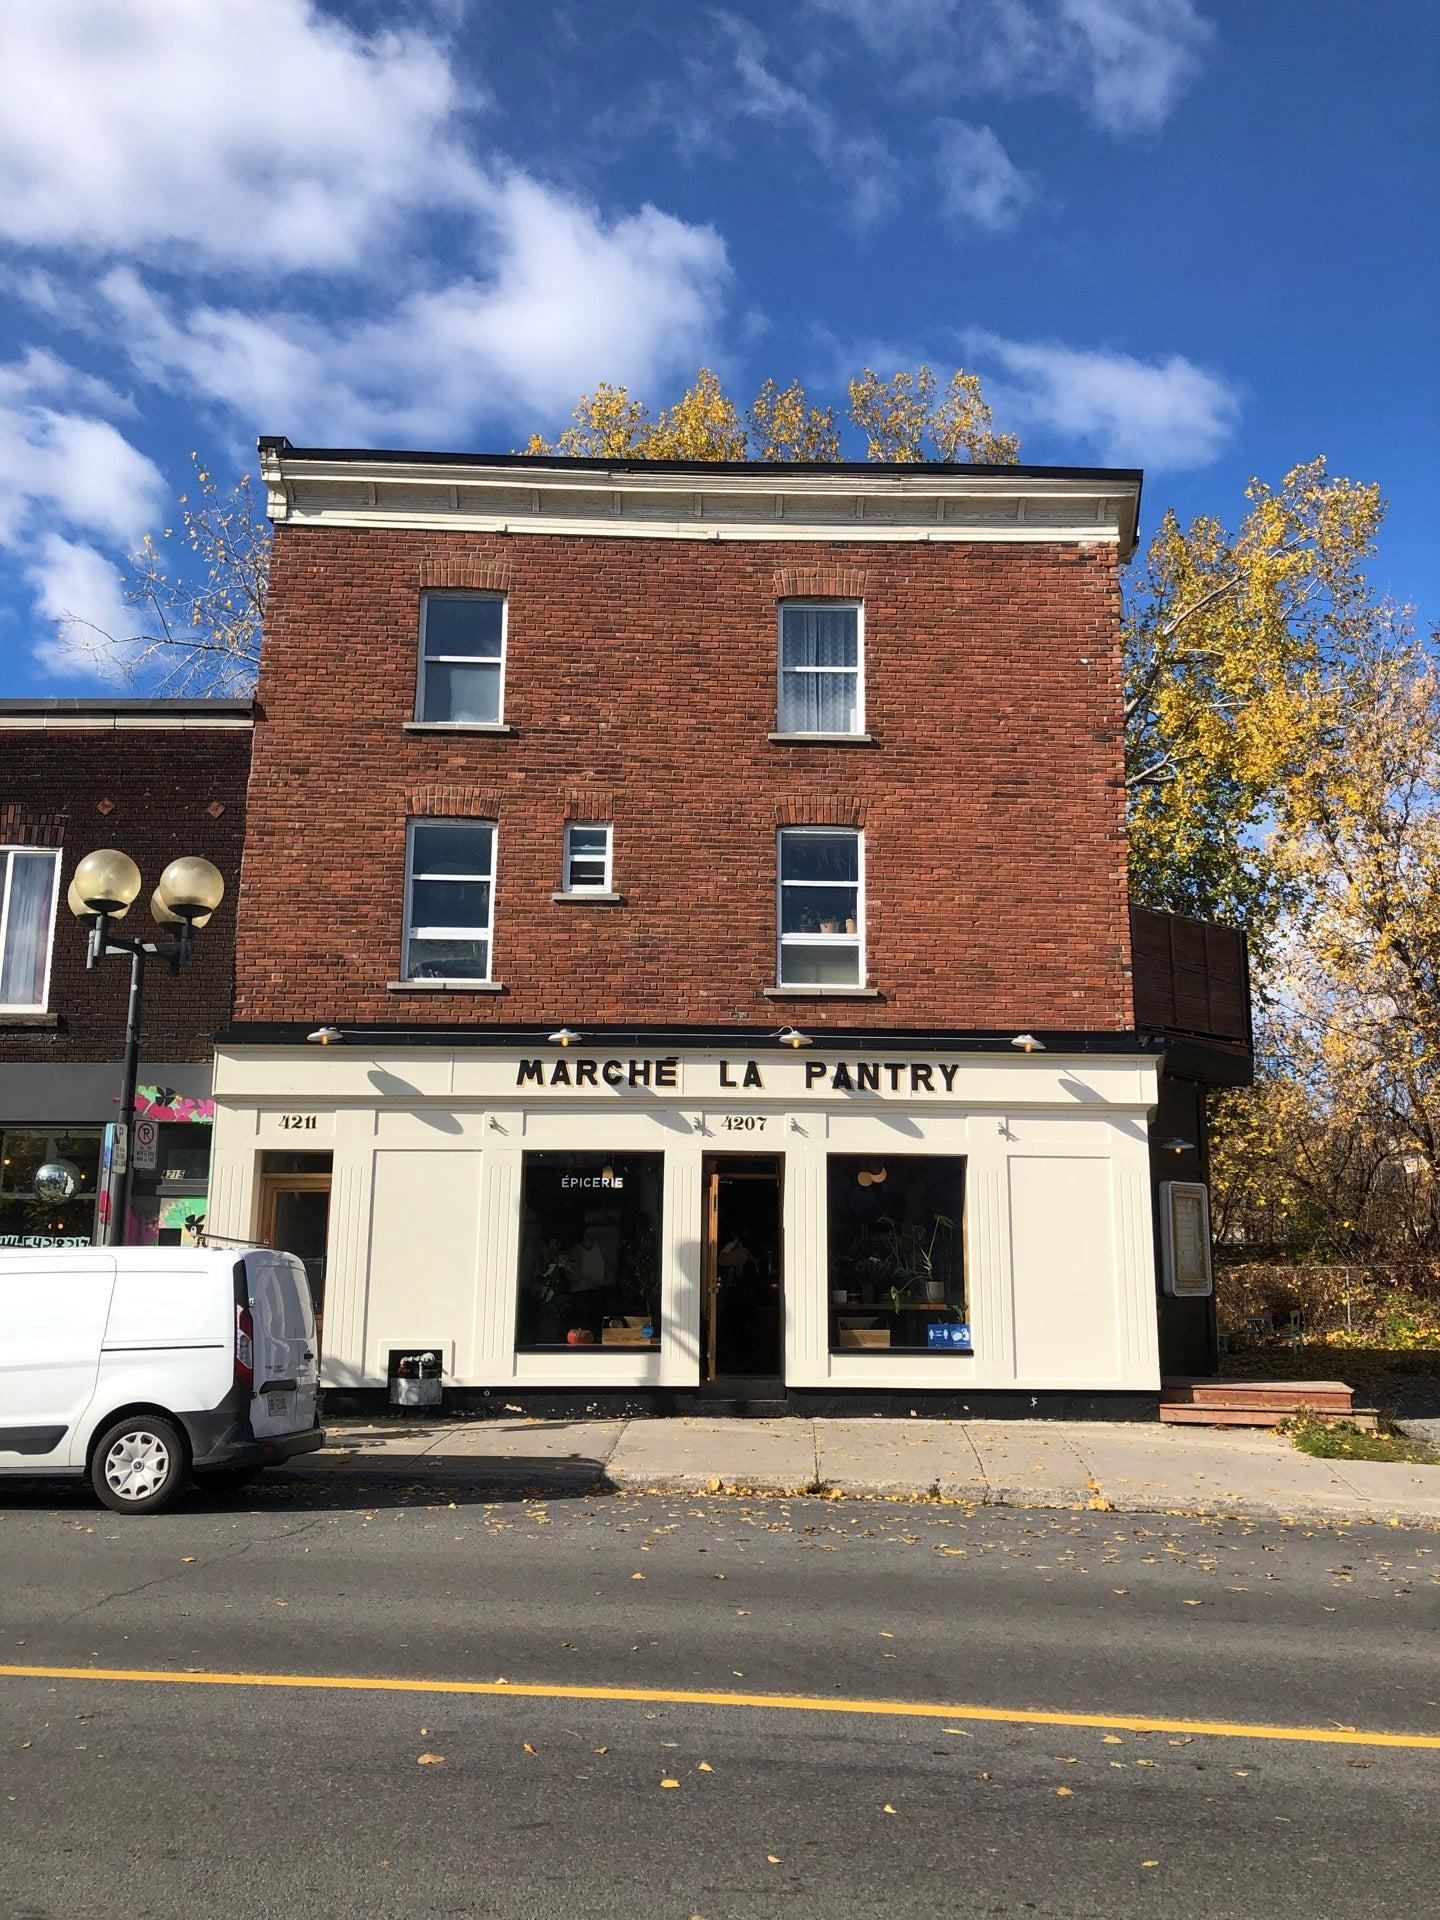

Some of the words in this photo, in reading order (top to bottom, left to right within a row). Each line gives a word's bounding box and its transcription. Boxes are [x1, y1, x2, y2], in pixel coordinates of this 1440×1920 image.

[516, 1056, 679, 1087] MARCHÉ
[719, 1060, 763, 1088] LA
[805, 1060, 960, 1092] PANTRY
[278, 1114, 317, 1130] 4211
[720, 1115, 767, 1131] 4207
[561, 1174, 624, 1189] ÉPICERIE
